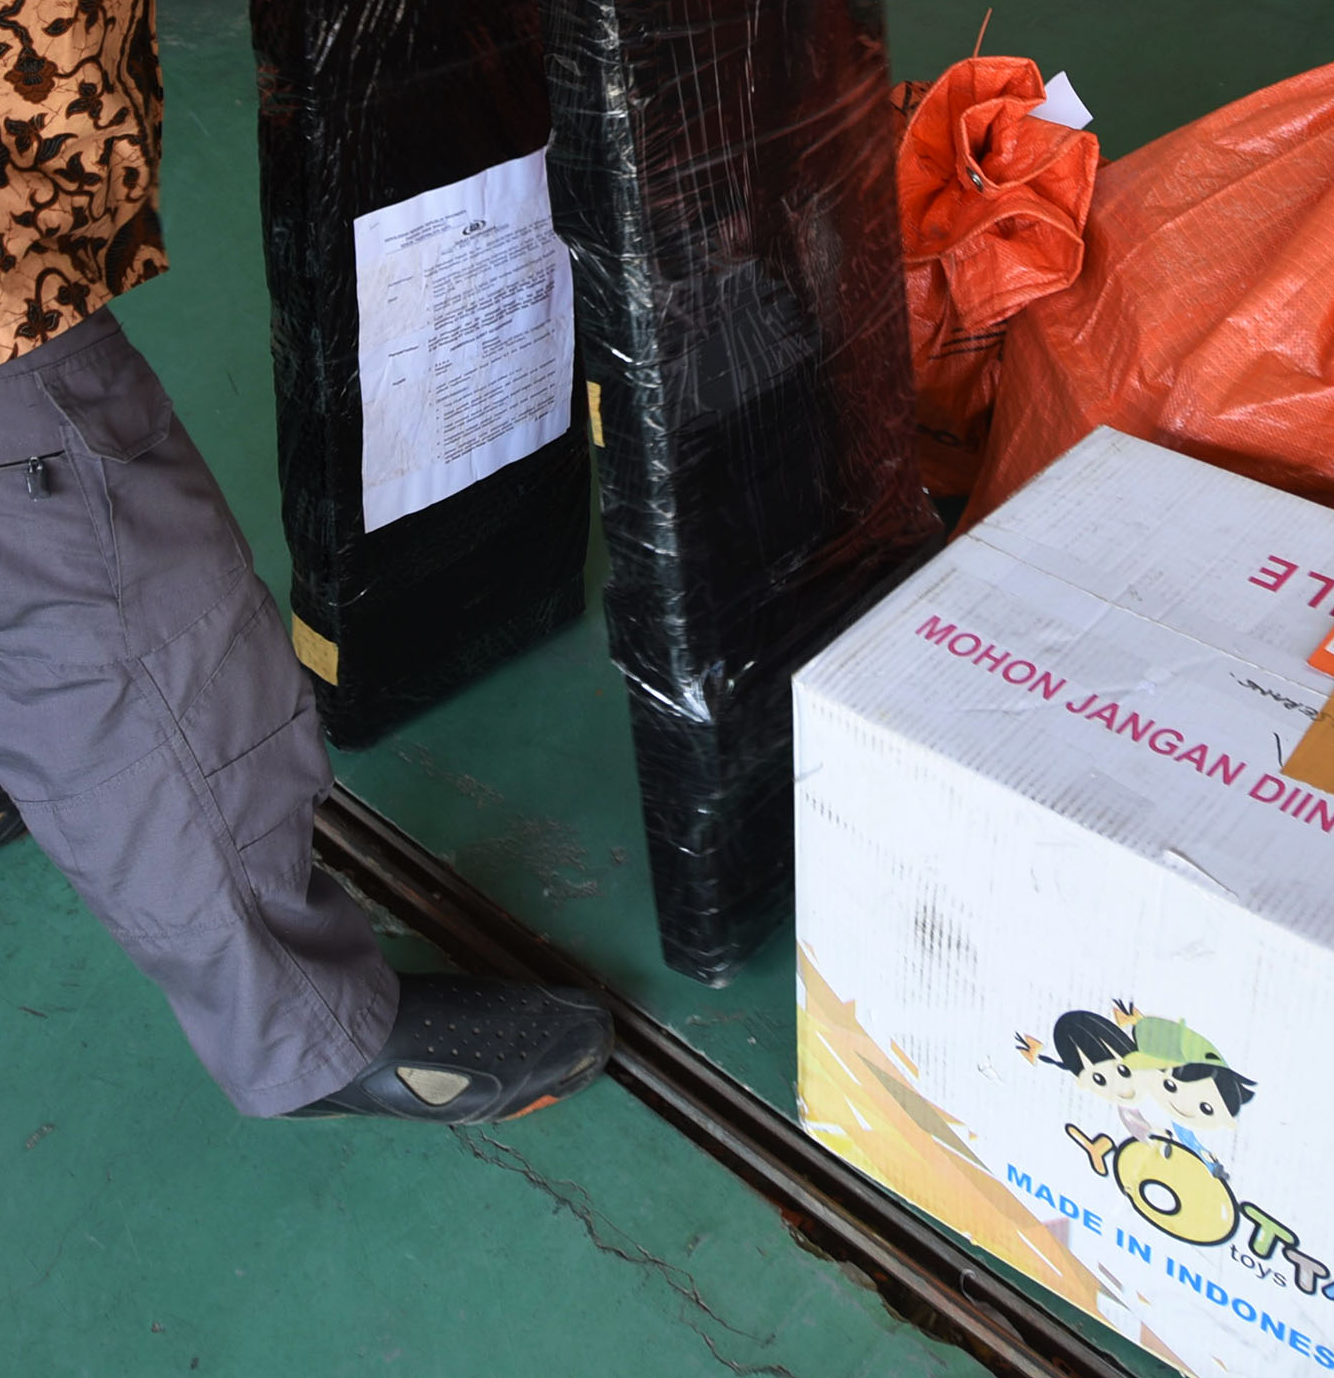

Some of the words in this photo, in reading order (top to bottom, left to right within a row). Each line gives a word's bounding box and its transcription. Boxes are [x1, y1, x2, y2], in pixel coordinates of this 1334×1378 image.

[915, 615, 1067, 701] MOHON
[1066, 693, 1247, 787] JANGAN
[1007, 1162, 1104, 1237] MADE
[1116, 1226, 1153, 1265] IN
[1228, 1243, 1288, 1289] toys
